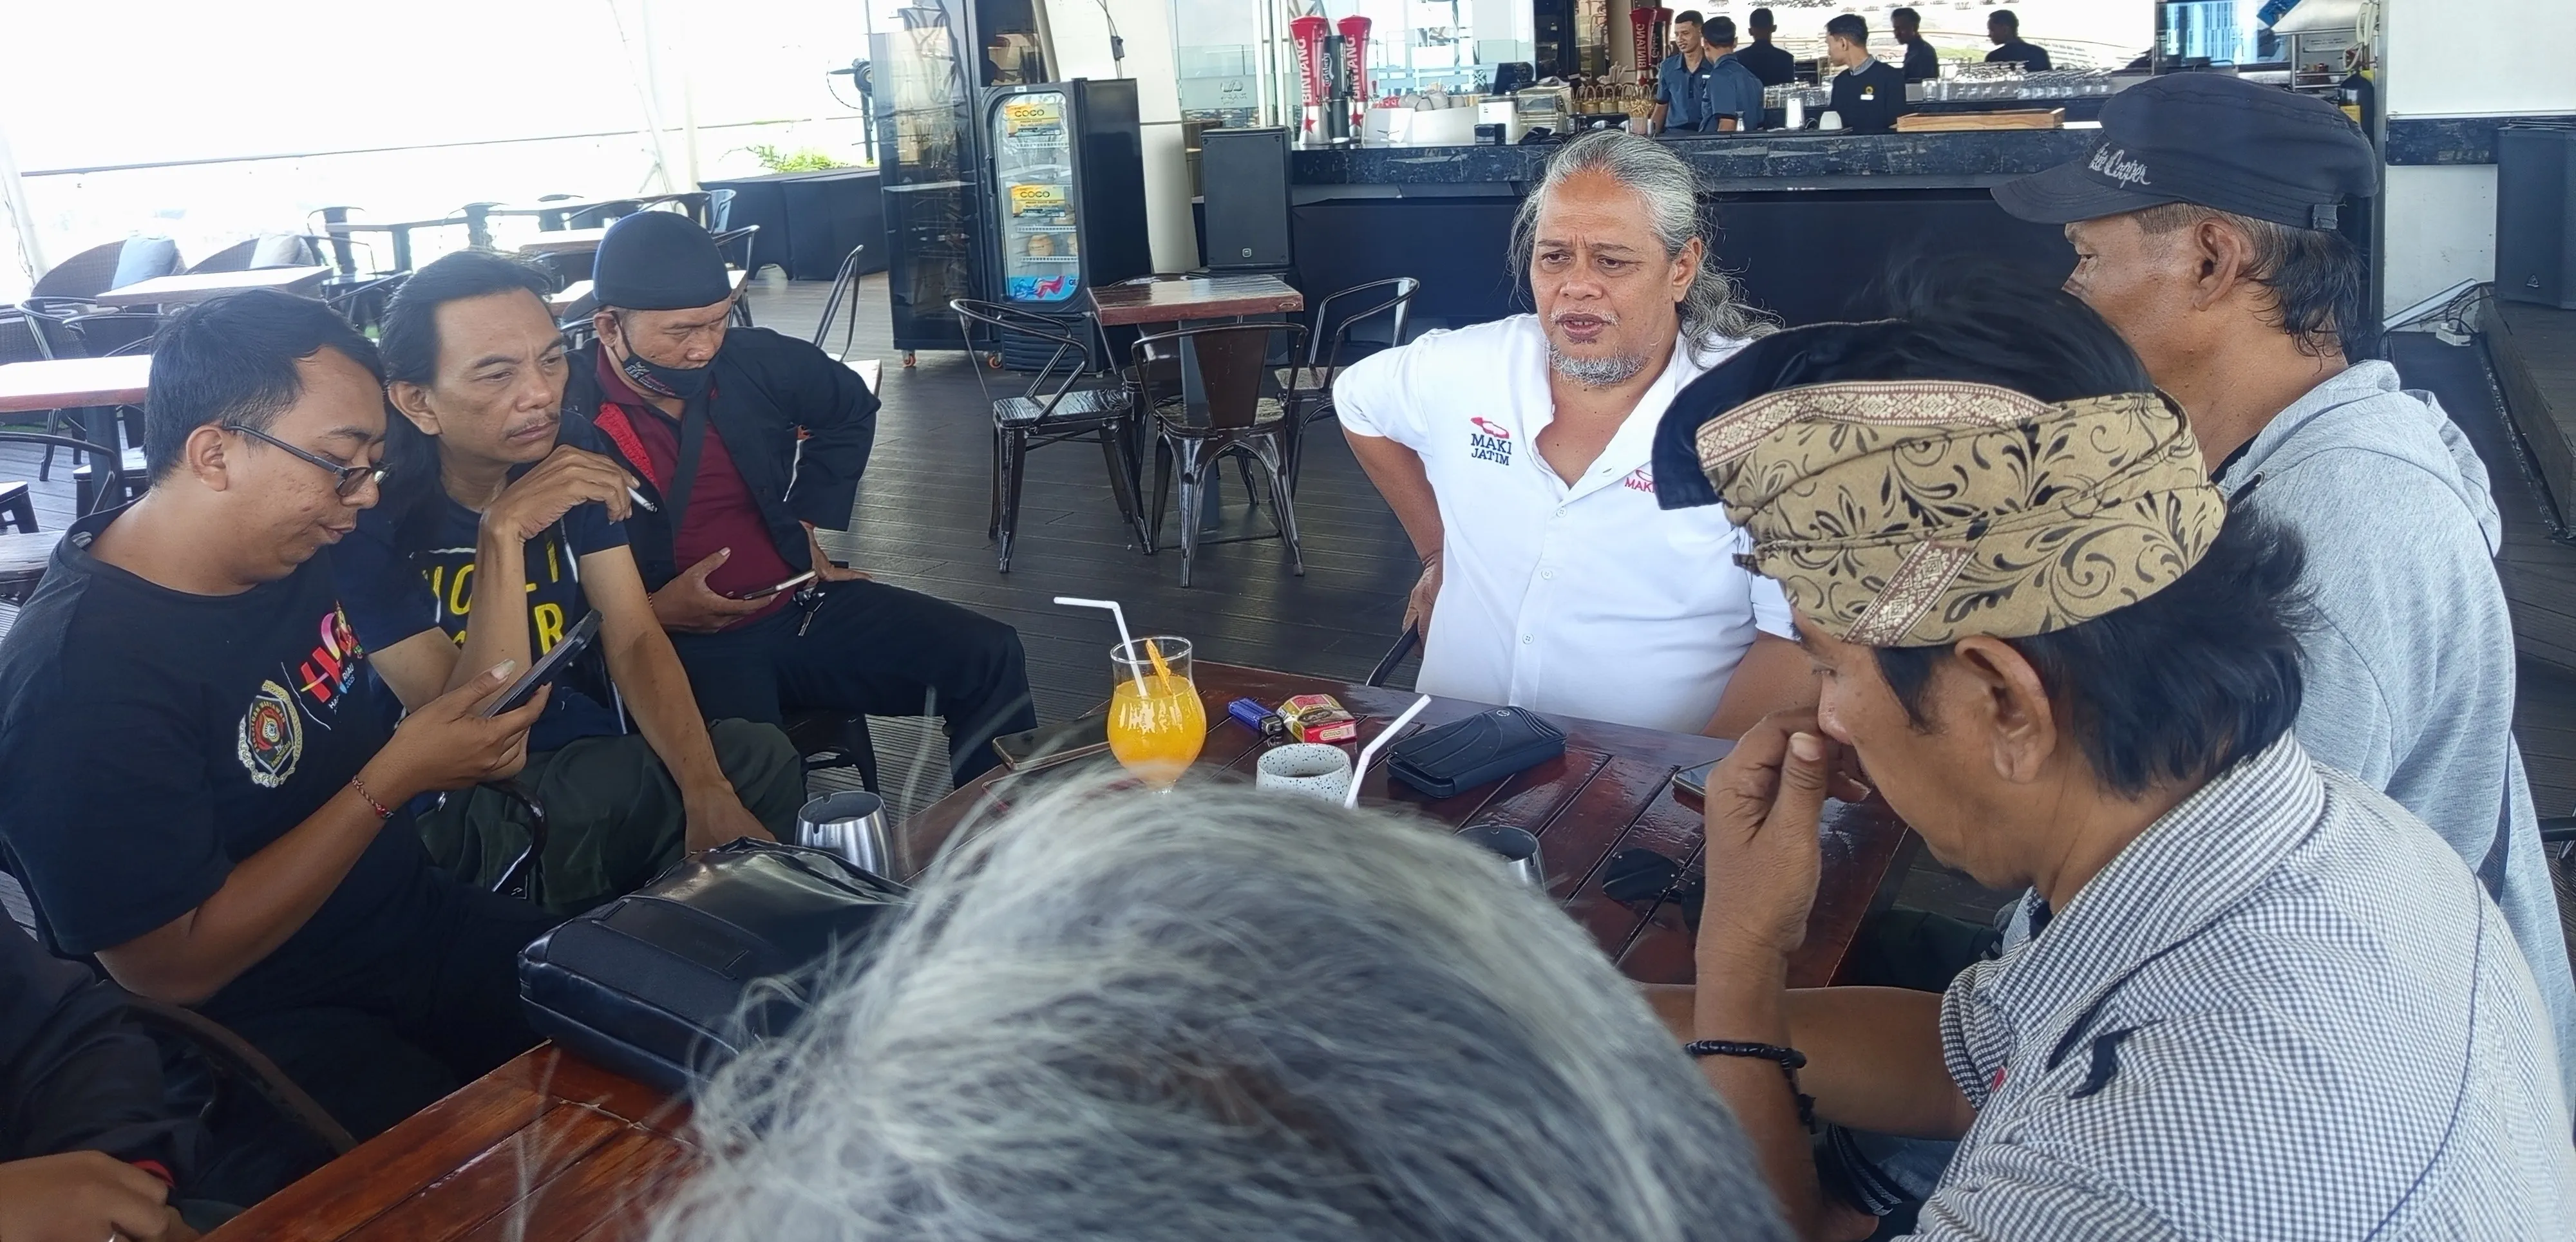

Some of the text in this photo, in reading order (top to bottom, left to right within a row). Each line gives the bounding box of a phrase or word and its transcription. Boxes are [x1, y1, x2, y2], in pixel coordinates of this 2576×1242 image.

[1296, 37, 1312, 103] BINTANG
[1014, 109, 1045, 117] COCO
[2104, 149, 2152, 189] Cooper
[1470, 433, 1512, 455] MAKI
[1471, 448, 1510, 466] JATIM
[342, 662, 354, 681] RIAU
